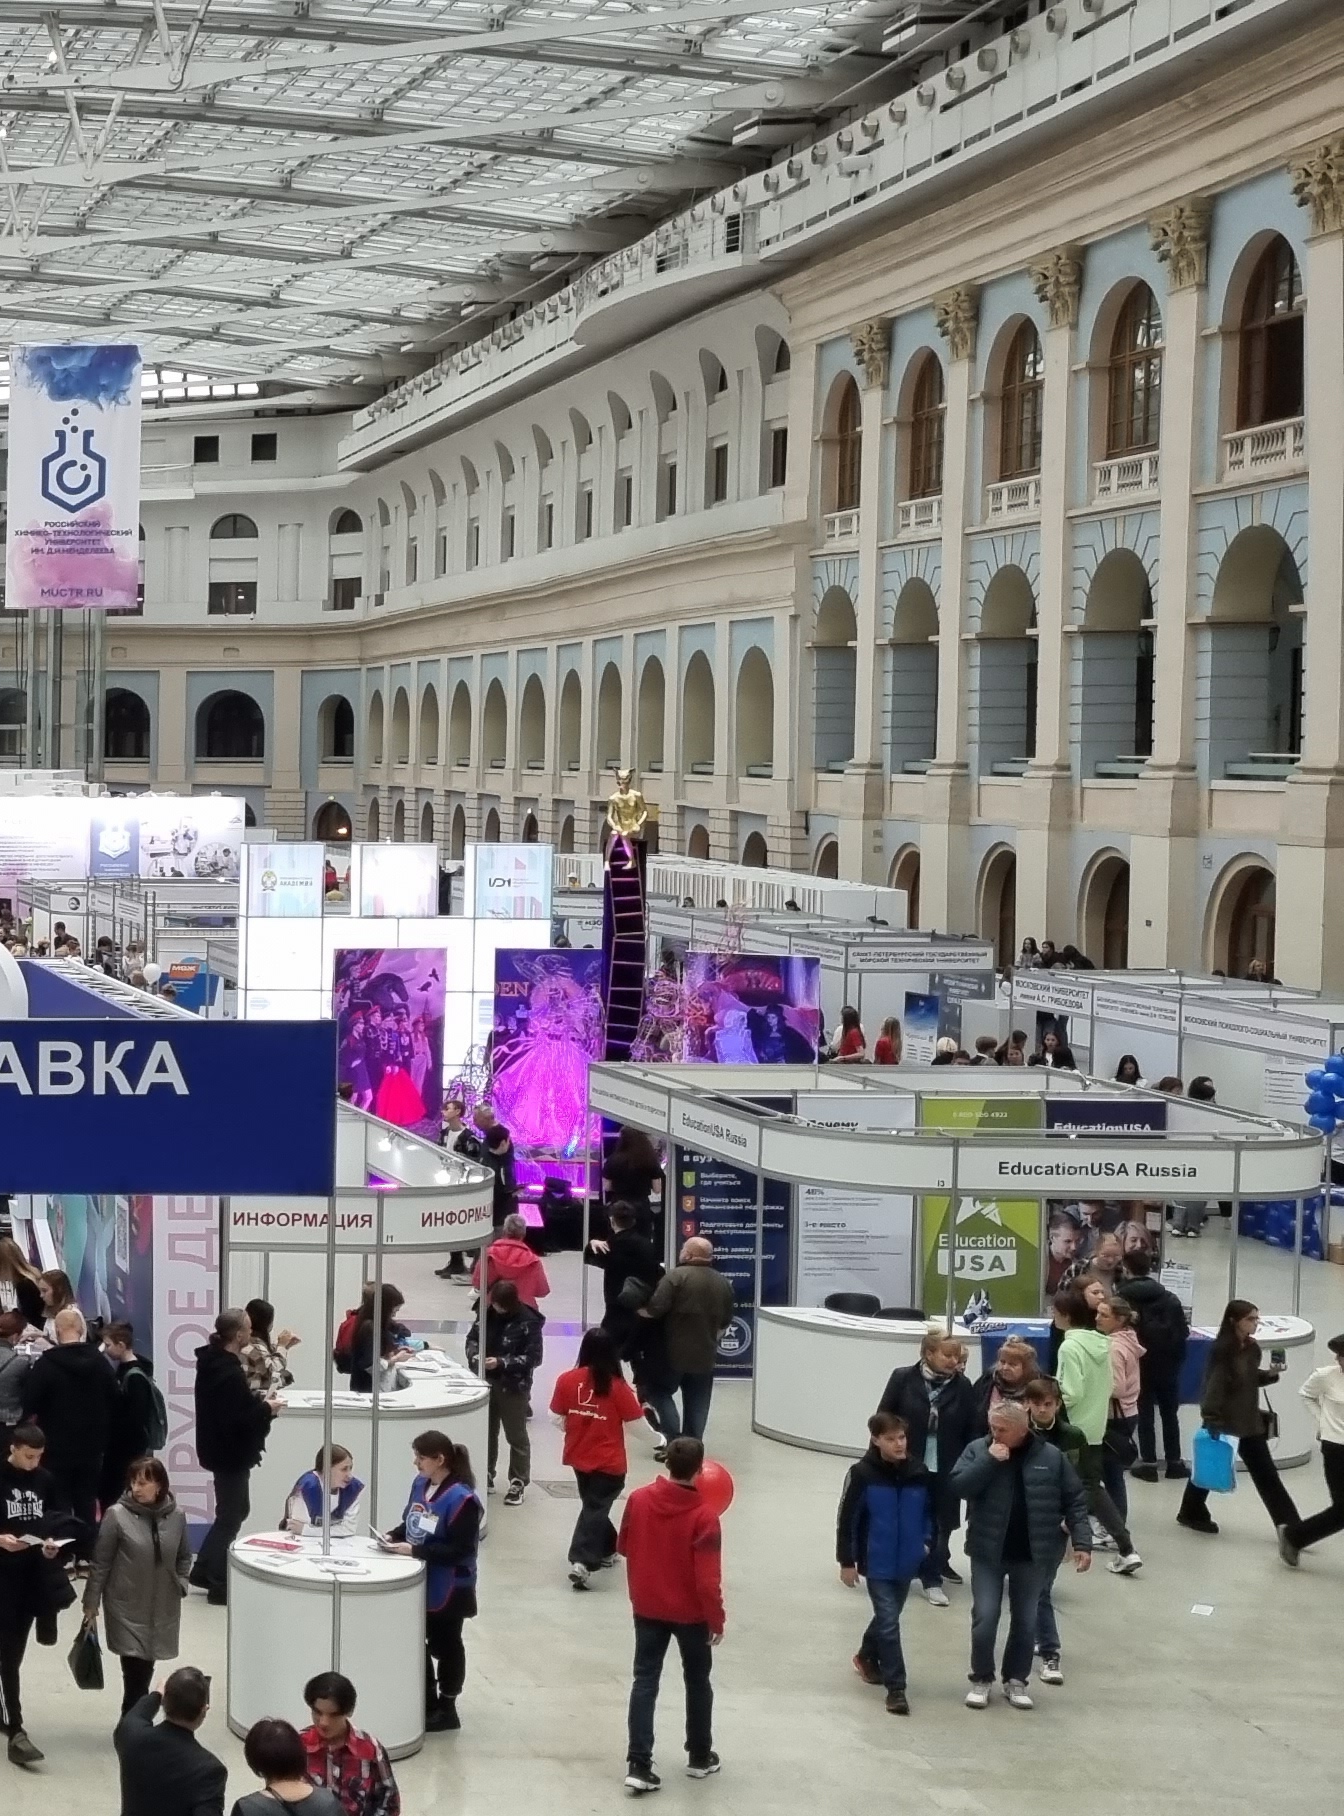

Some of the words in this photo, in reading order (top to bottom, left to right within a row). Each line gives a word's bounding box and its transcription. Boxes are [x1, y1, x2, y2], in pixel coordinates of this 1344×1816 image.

[682, 1113, 724, 1139] EducationUSA
[725, 1128, 747, 1148] Russia
[1053, 1122, 1152, 1132] EducationUSA
[998, 1161, 1129, 1177] EducationUSA
[1136, 1163, 1198, 1178] Russia
[232, 1211, 373, 1230] ИНФОРМАЦИЯ
[951, 1255, 1007, 1272] USA
